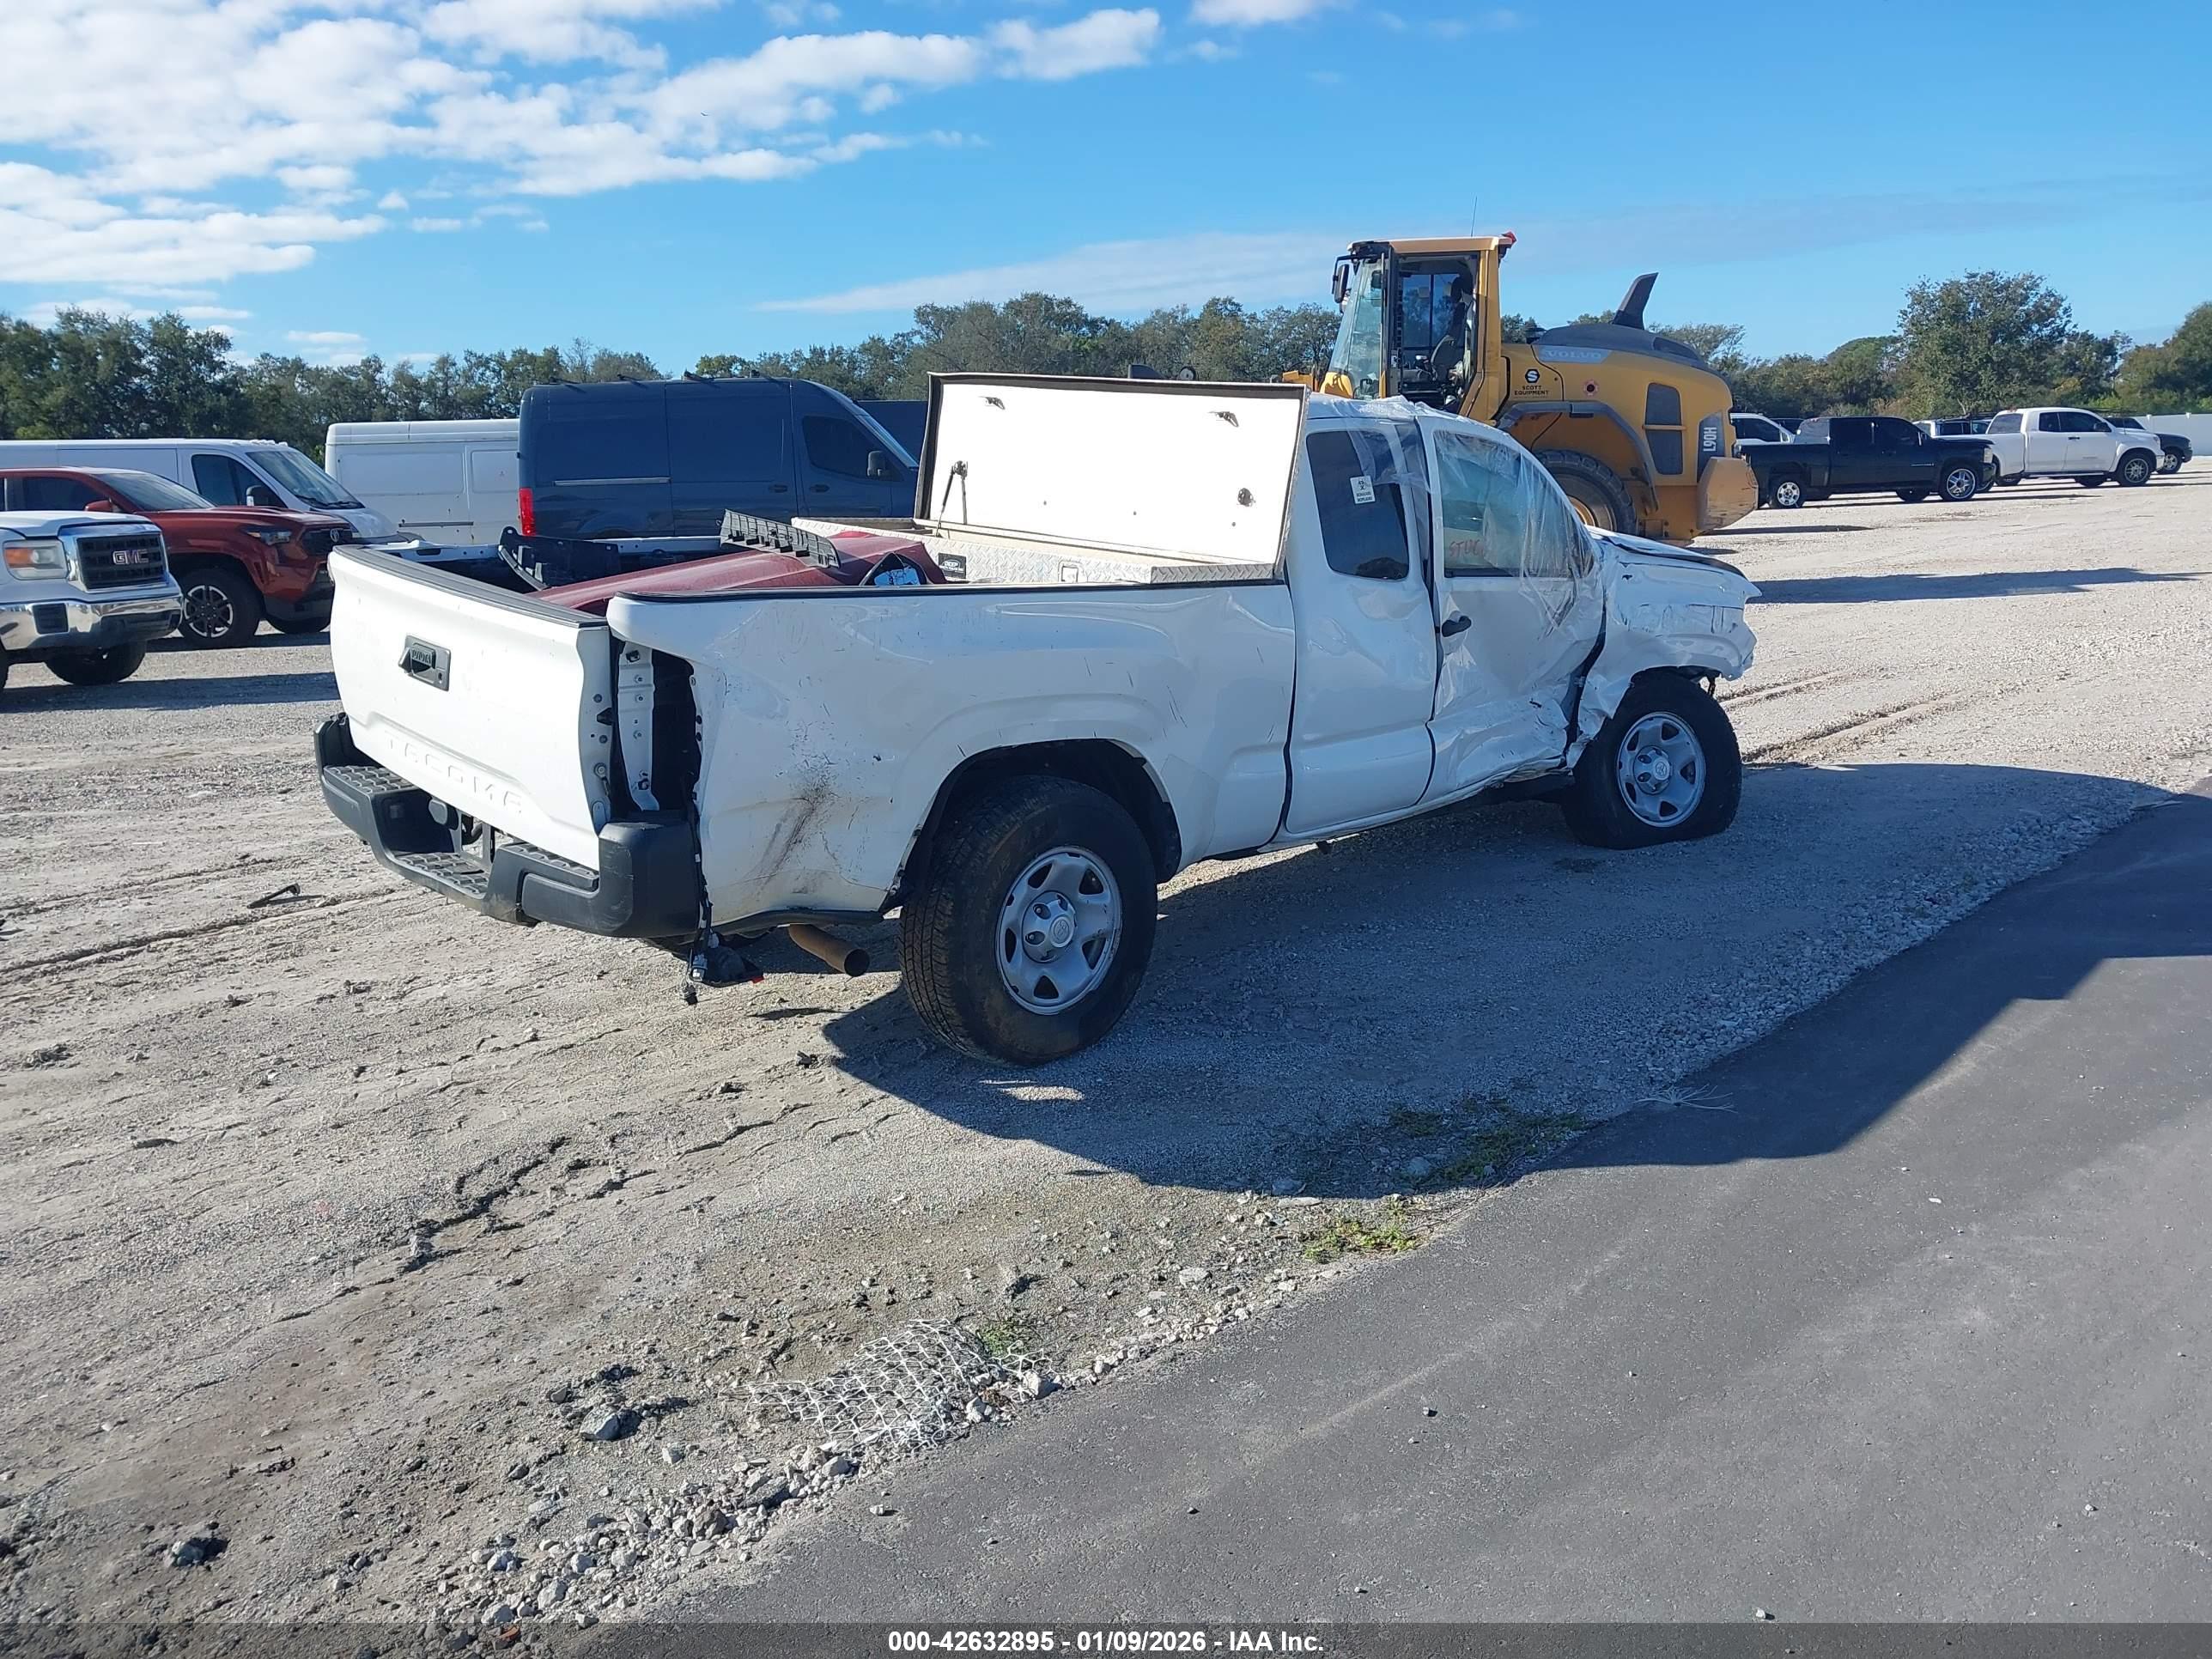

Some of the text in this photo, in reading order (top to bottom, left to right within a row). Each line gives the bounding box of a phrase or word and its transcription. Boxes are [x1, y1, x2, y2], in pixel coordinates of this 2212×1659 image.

[1547, 350, 1601, 359] VOLVO
[1703, 427, 1717, 452] L90H
[112, 549, 149, 565] GMC
